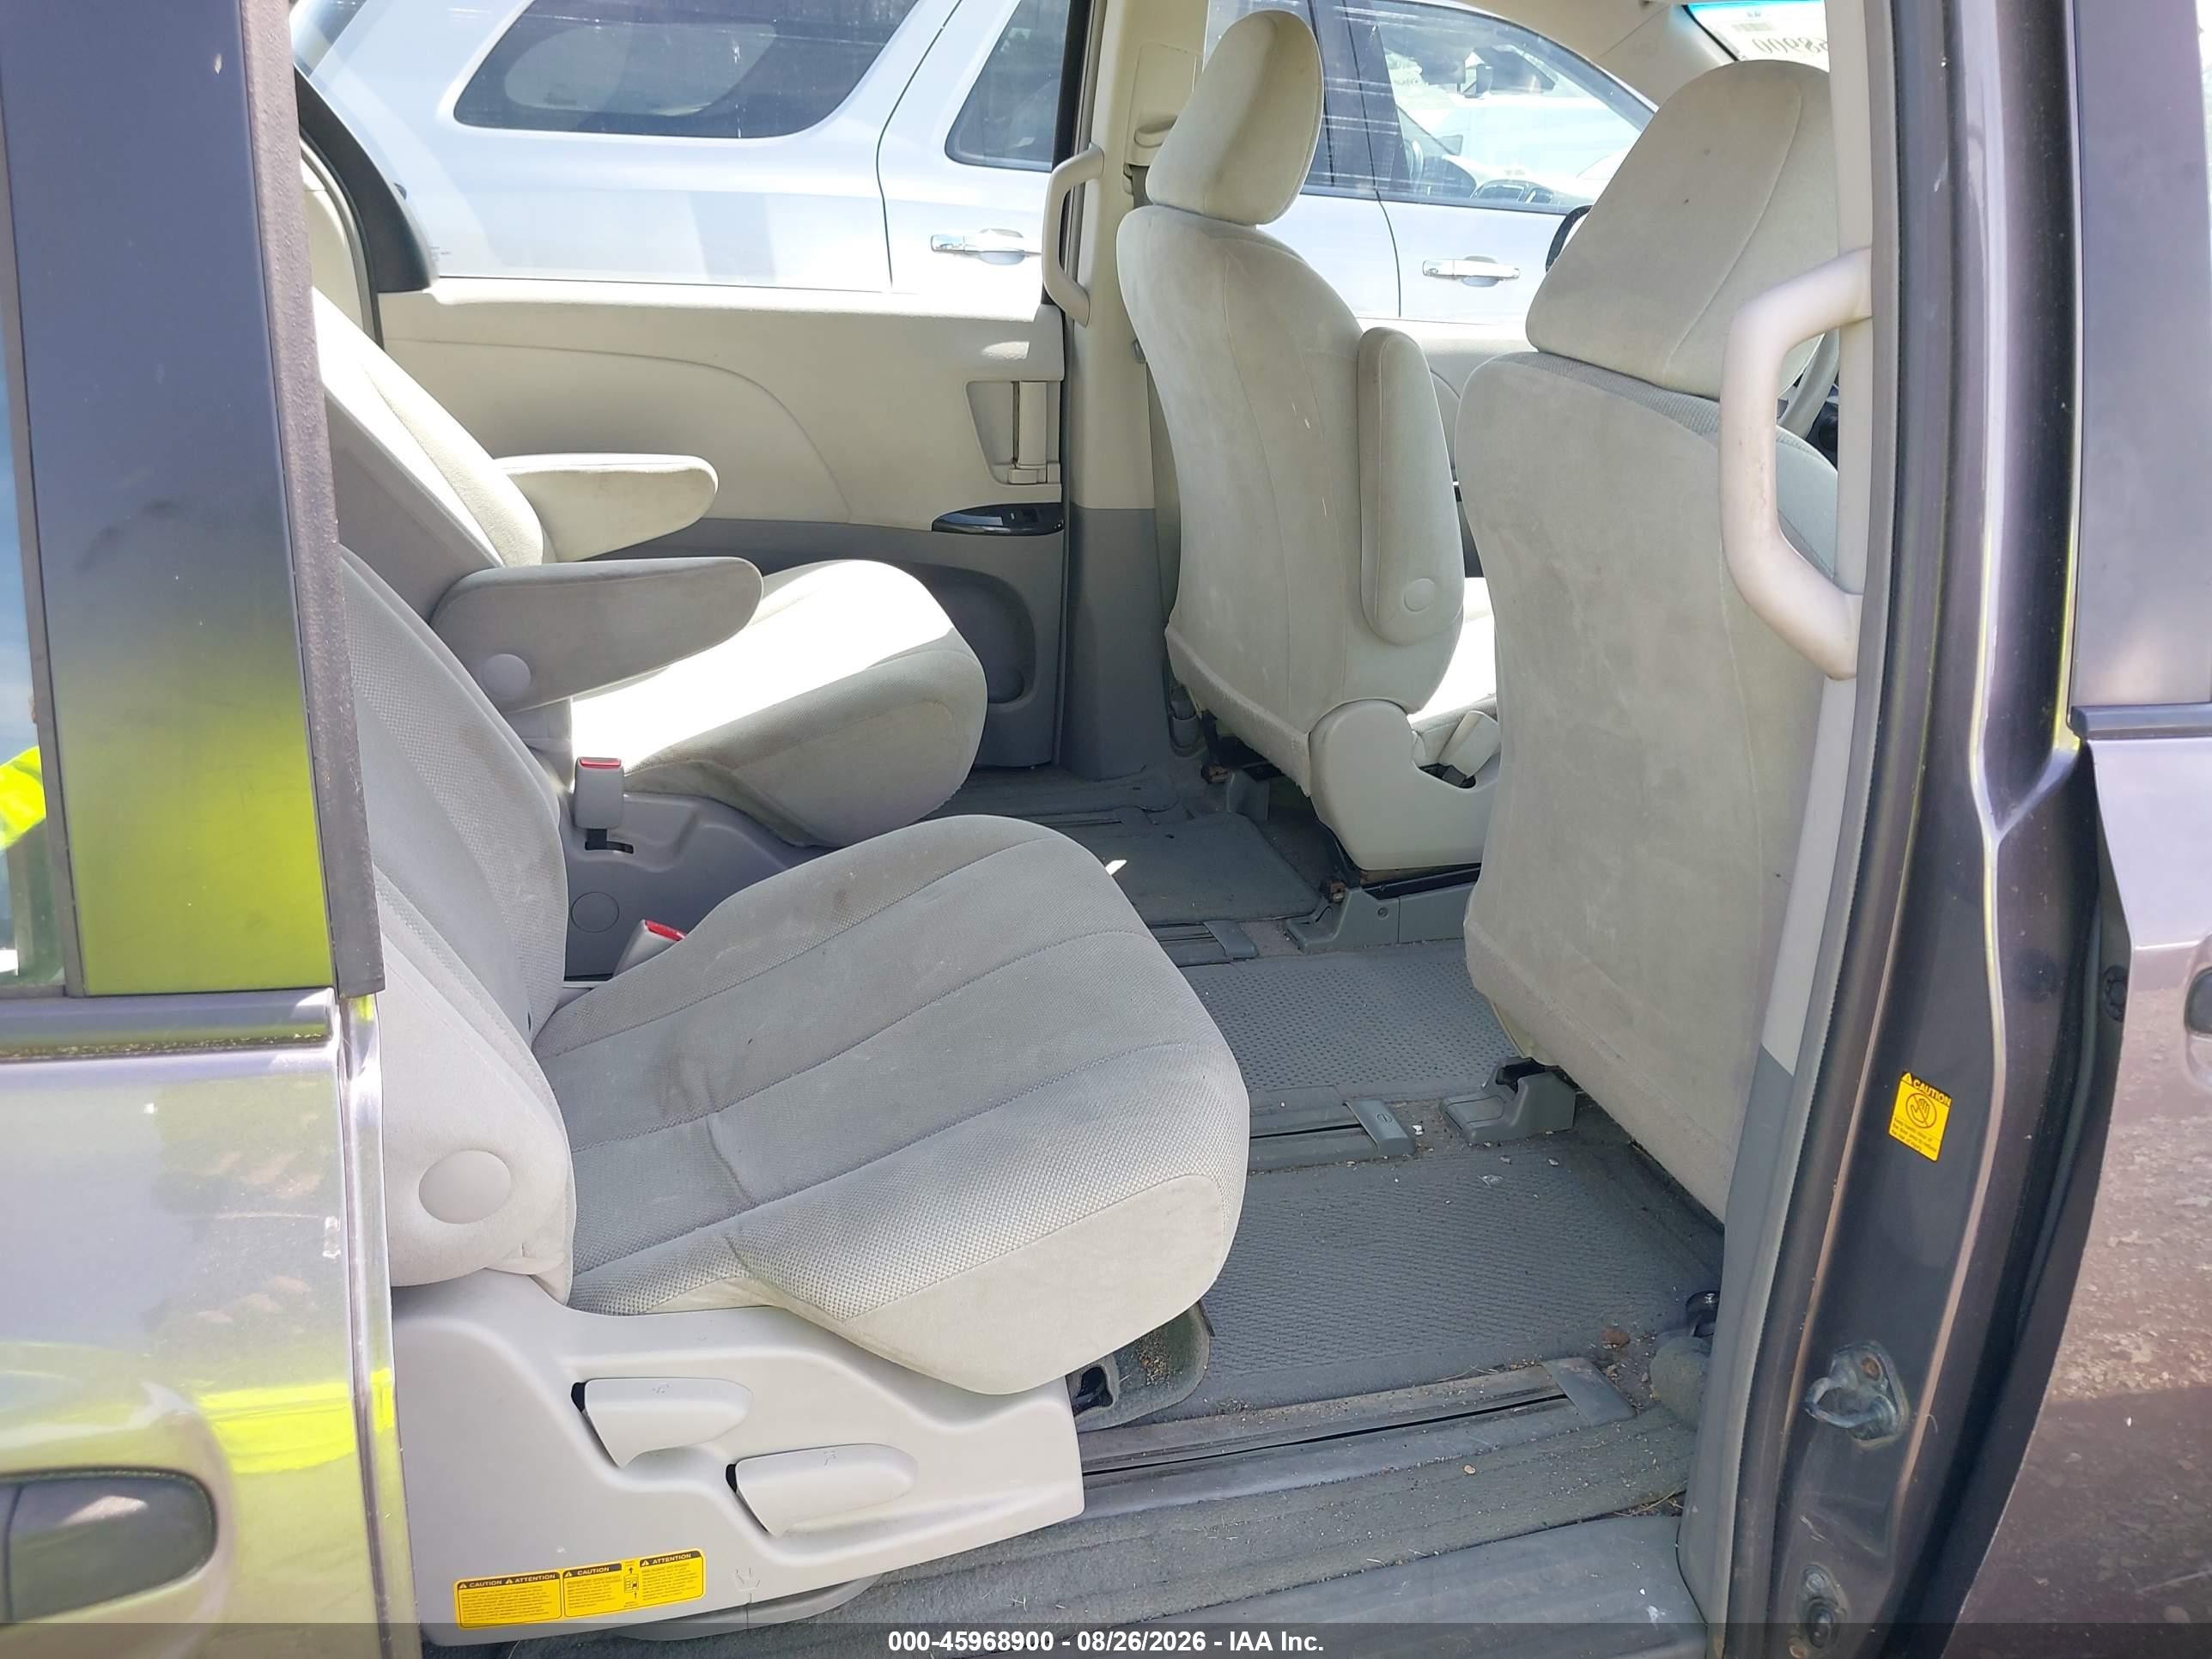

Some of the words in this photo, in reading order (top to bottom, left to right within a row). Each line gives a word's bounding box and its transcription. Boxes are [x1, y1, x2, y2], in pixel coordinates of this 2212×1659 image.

[1913, 1079, 1951, 1107] CAUTION
[653, 1553, 691, 1564] ATTENTION
[577, 1566, 610, 1576] CAUTION
[514, 1574, 556, 1583] ATTENTION
